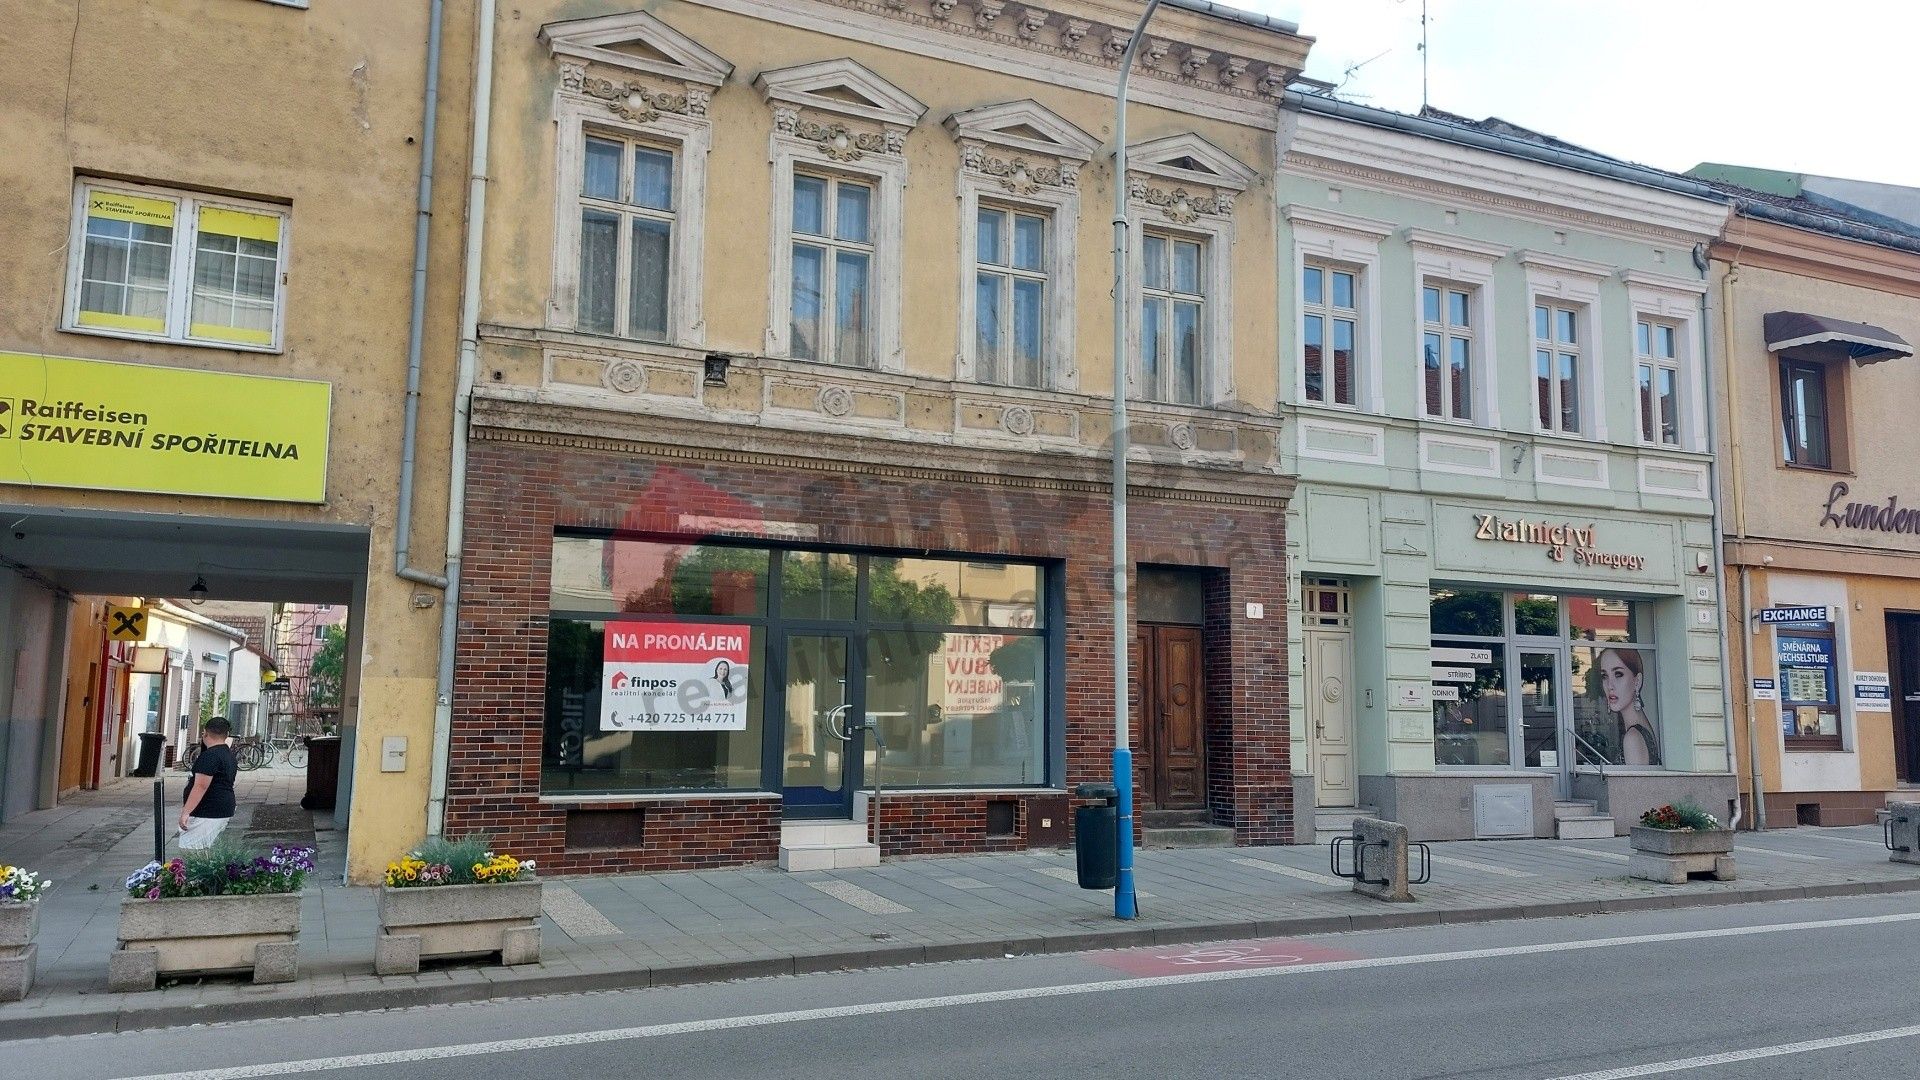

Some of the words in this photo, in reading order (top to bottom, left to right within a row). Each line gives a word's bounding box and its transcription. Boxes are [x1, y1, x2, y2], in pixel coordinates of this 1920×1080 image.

[105, 201, 135, 210] Raiffeisen
[105, 207, 134, 215] STAVEBNÍ
[135, 210, 171, 220] SPOŘITELNA
[20, 399, 148, 425] Raiffeisen
[19, 423, 145, 449] STAVEBNÍ
[150, 433, 299, 460] SPOŘITELNA
[1473, 513, 1596, 548] Zlatnictví
[1574, 547, 1646, 570] Synagogy
[1763, 608, 1826, 621] EXCHANGE
[612, 633, 639, 649] NA
[644, 633, 742, 651] PRONÁJEM
[1782, 640, 1821, 653] SMĚNÁRNA
[1470, 652, 1489, 660] ZLATO
[630, 676, 677, 690] finpos
[628, 713, 660, 723] +420
[664, 713, 686, 723] 725
[690, 713, 711, 723] 144
[715, 713, 736, 723] 771
